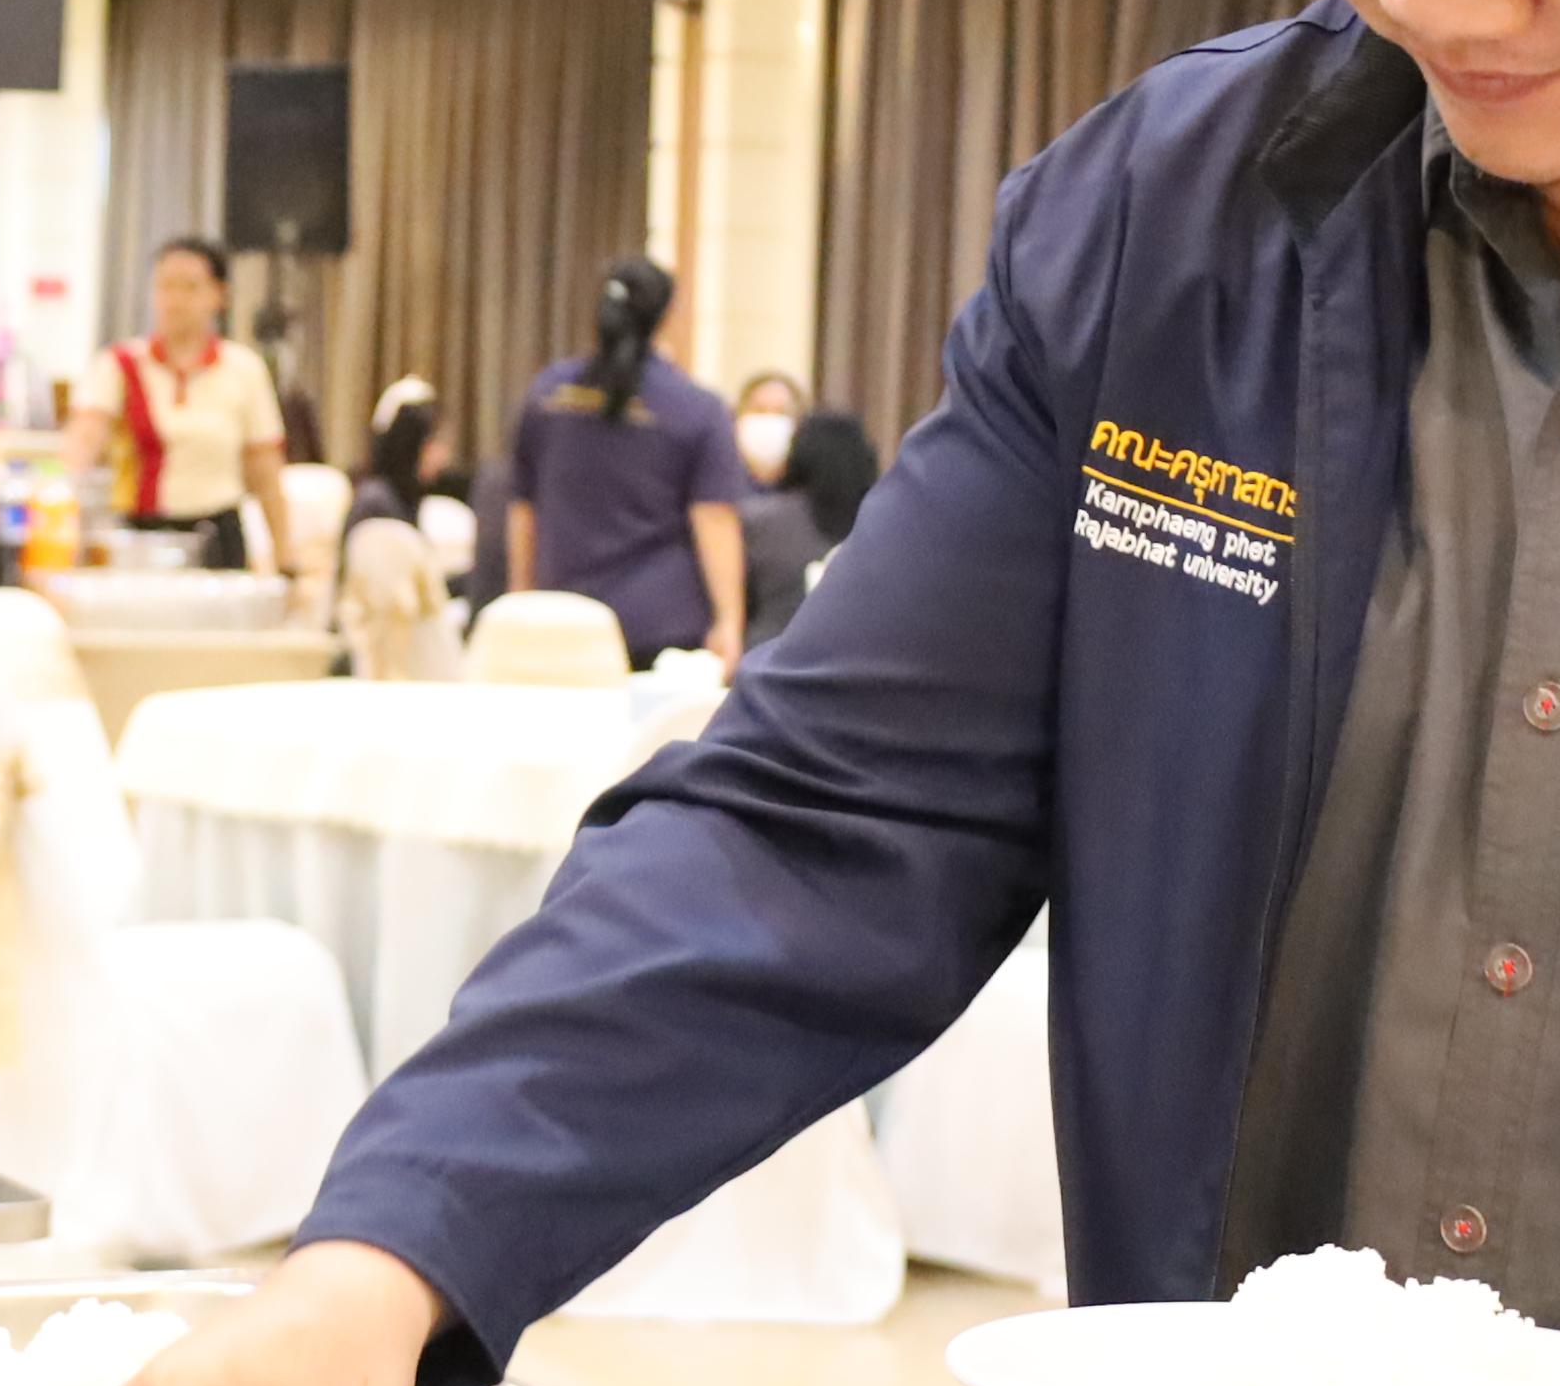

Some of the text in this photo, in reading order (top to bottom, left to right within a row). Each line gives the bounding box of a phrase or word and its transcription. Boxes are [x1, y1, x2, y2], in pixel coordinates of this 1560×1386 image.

[1073, 509, 1279, 606] Rajabhat university
[1084, 479, 1277, 567] Kamphaeng phet
